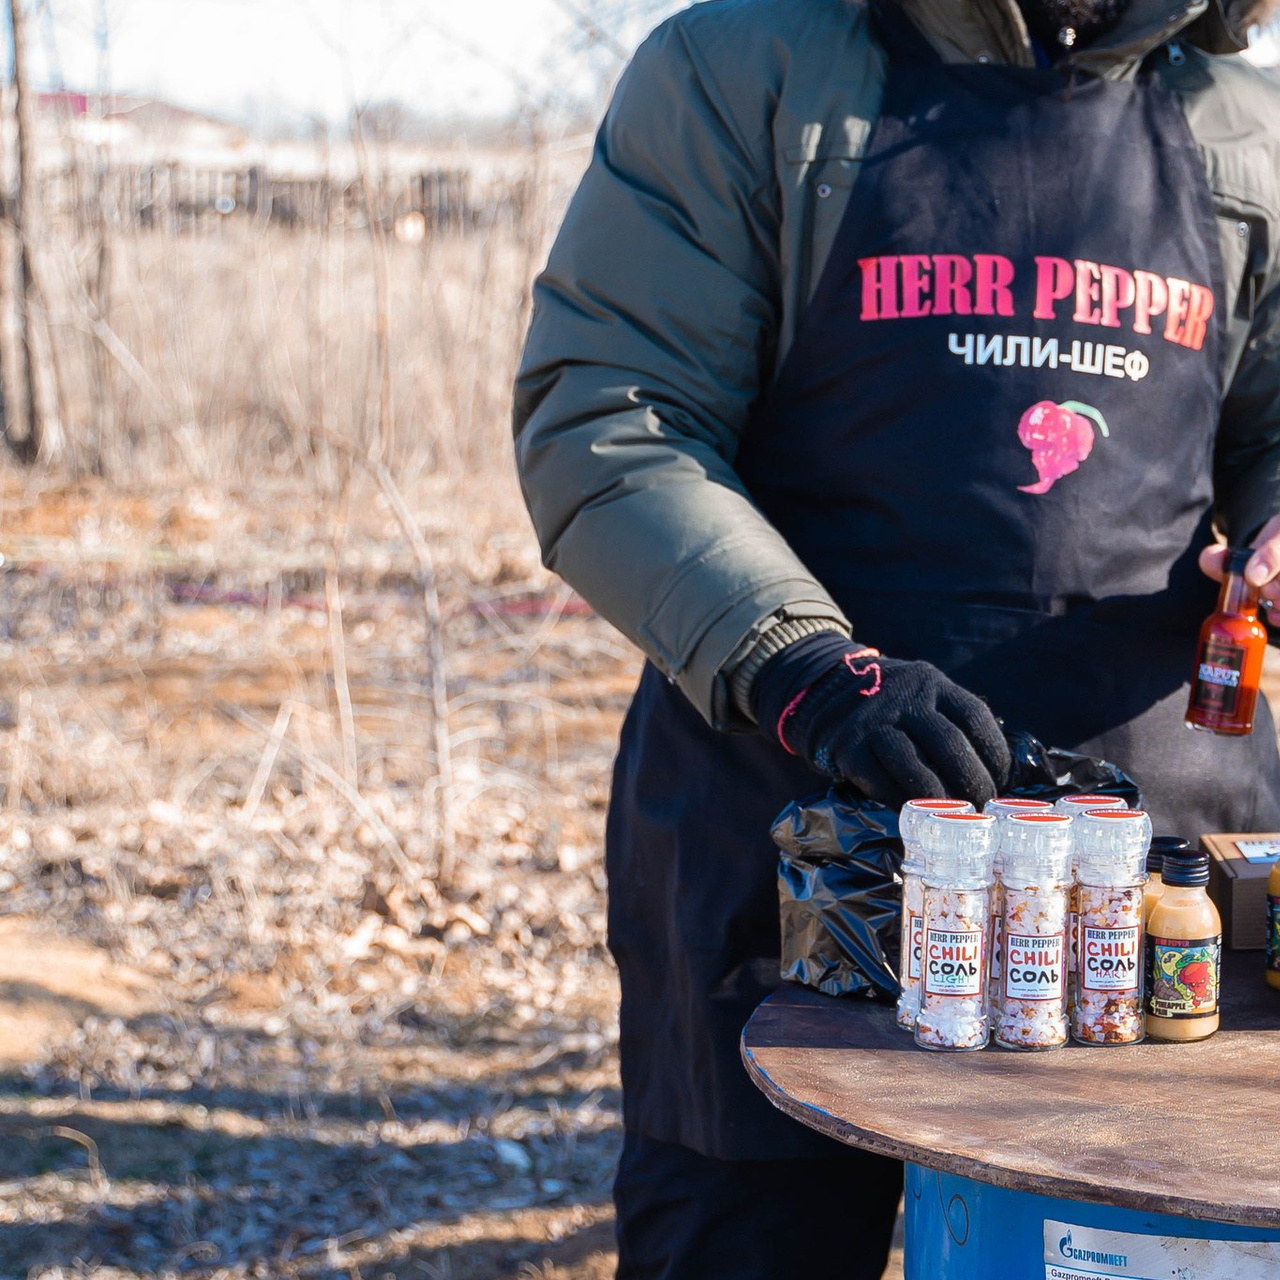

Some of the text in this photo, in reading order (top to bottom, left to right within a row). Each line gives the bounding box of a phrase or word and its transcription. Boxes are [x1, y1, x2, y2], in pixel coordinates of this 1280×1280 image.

[857, 254, 1214, 351] HERR PEPPER
[948, 333, 1149, 381] ЧИЛИ-ШЕФ
[1087, 930, 1135, 940] HERR PEPPER
[1032, 938, 1060, 949] PEPPER
[1087, 941, 1134, 957] CHILI
[929, 944, 977, 961] CHILI
[1010, 949, 1059, 966] CHILI
[929, 960, 977, 976] СОЛЬ
[1087, 957, 1135, 971] СОЛЬ
[1010, 968, 1058, 984] СОЛЬ
